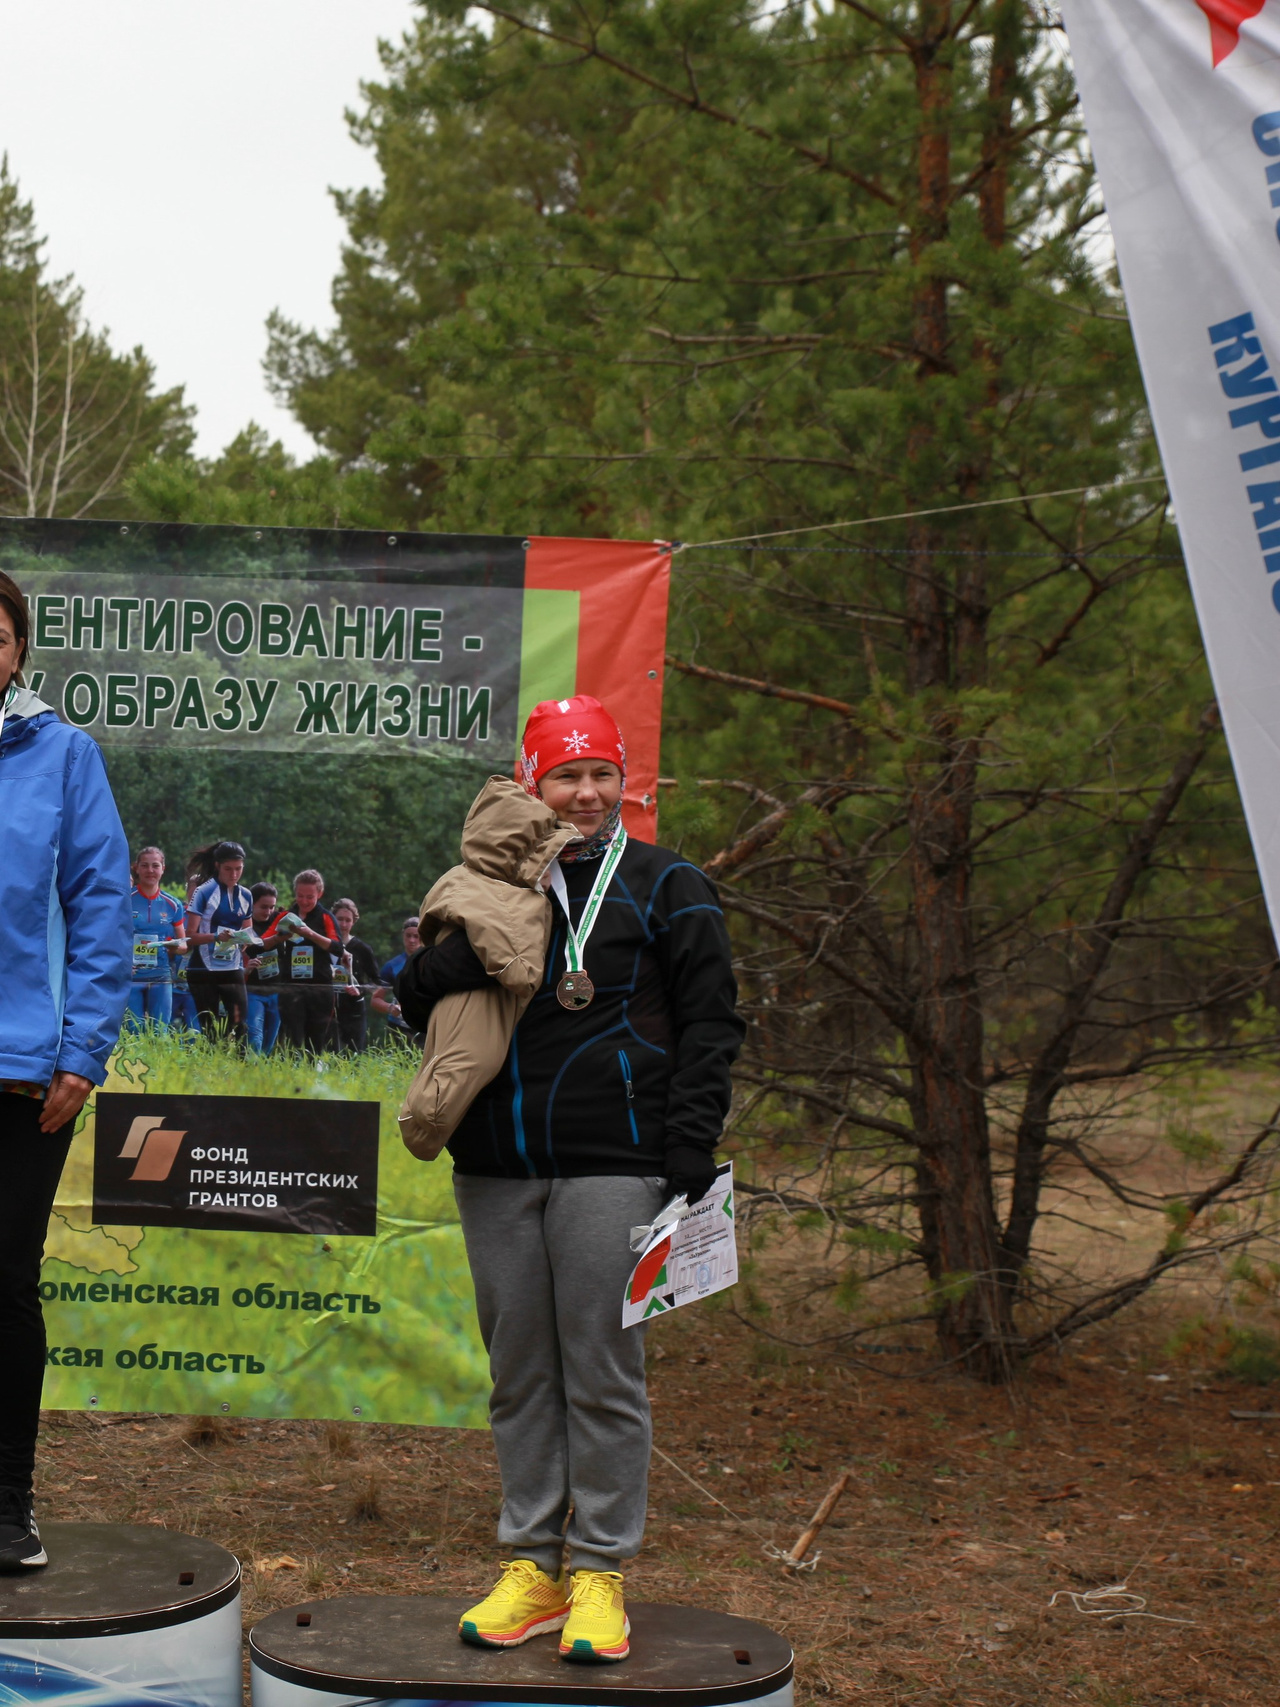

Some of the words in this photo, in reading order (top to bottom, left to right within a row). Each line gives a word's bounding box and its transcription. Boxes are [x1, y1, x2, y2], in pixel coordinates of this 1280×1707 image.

[63, 671, 279, 732] ОБРАЗУ
[295, 681, 492, 741] ЖИЗНИ
[190, 1146, 248, 1165] ФОНД
[189, 1168, 360, 1190] ПРЕЗИДЕНТСКИХ
[188, 1191, 279, 1209] ГРАНТОВ
[232, 1281, 382, 1315] область
[115, 1343, 266, 1375] область
